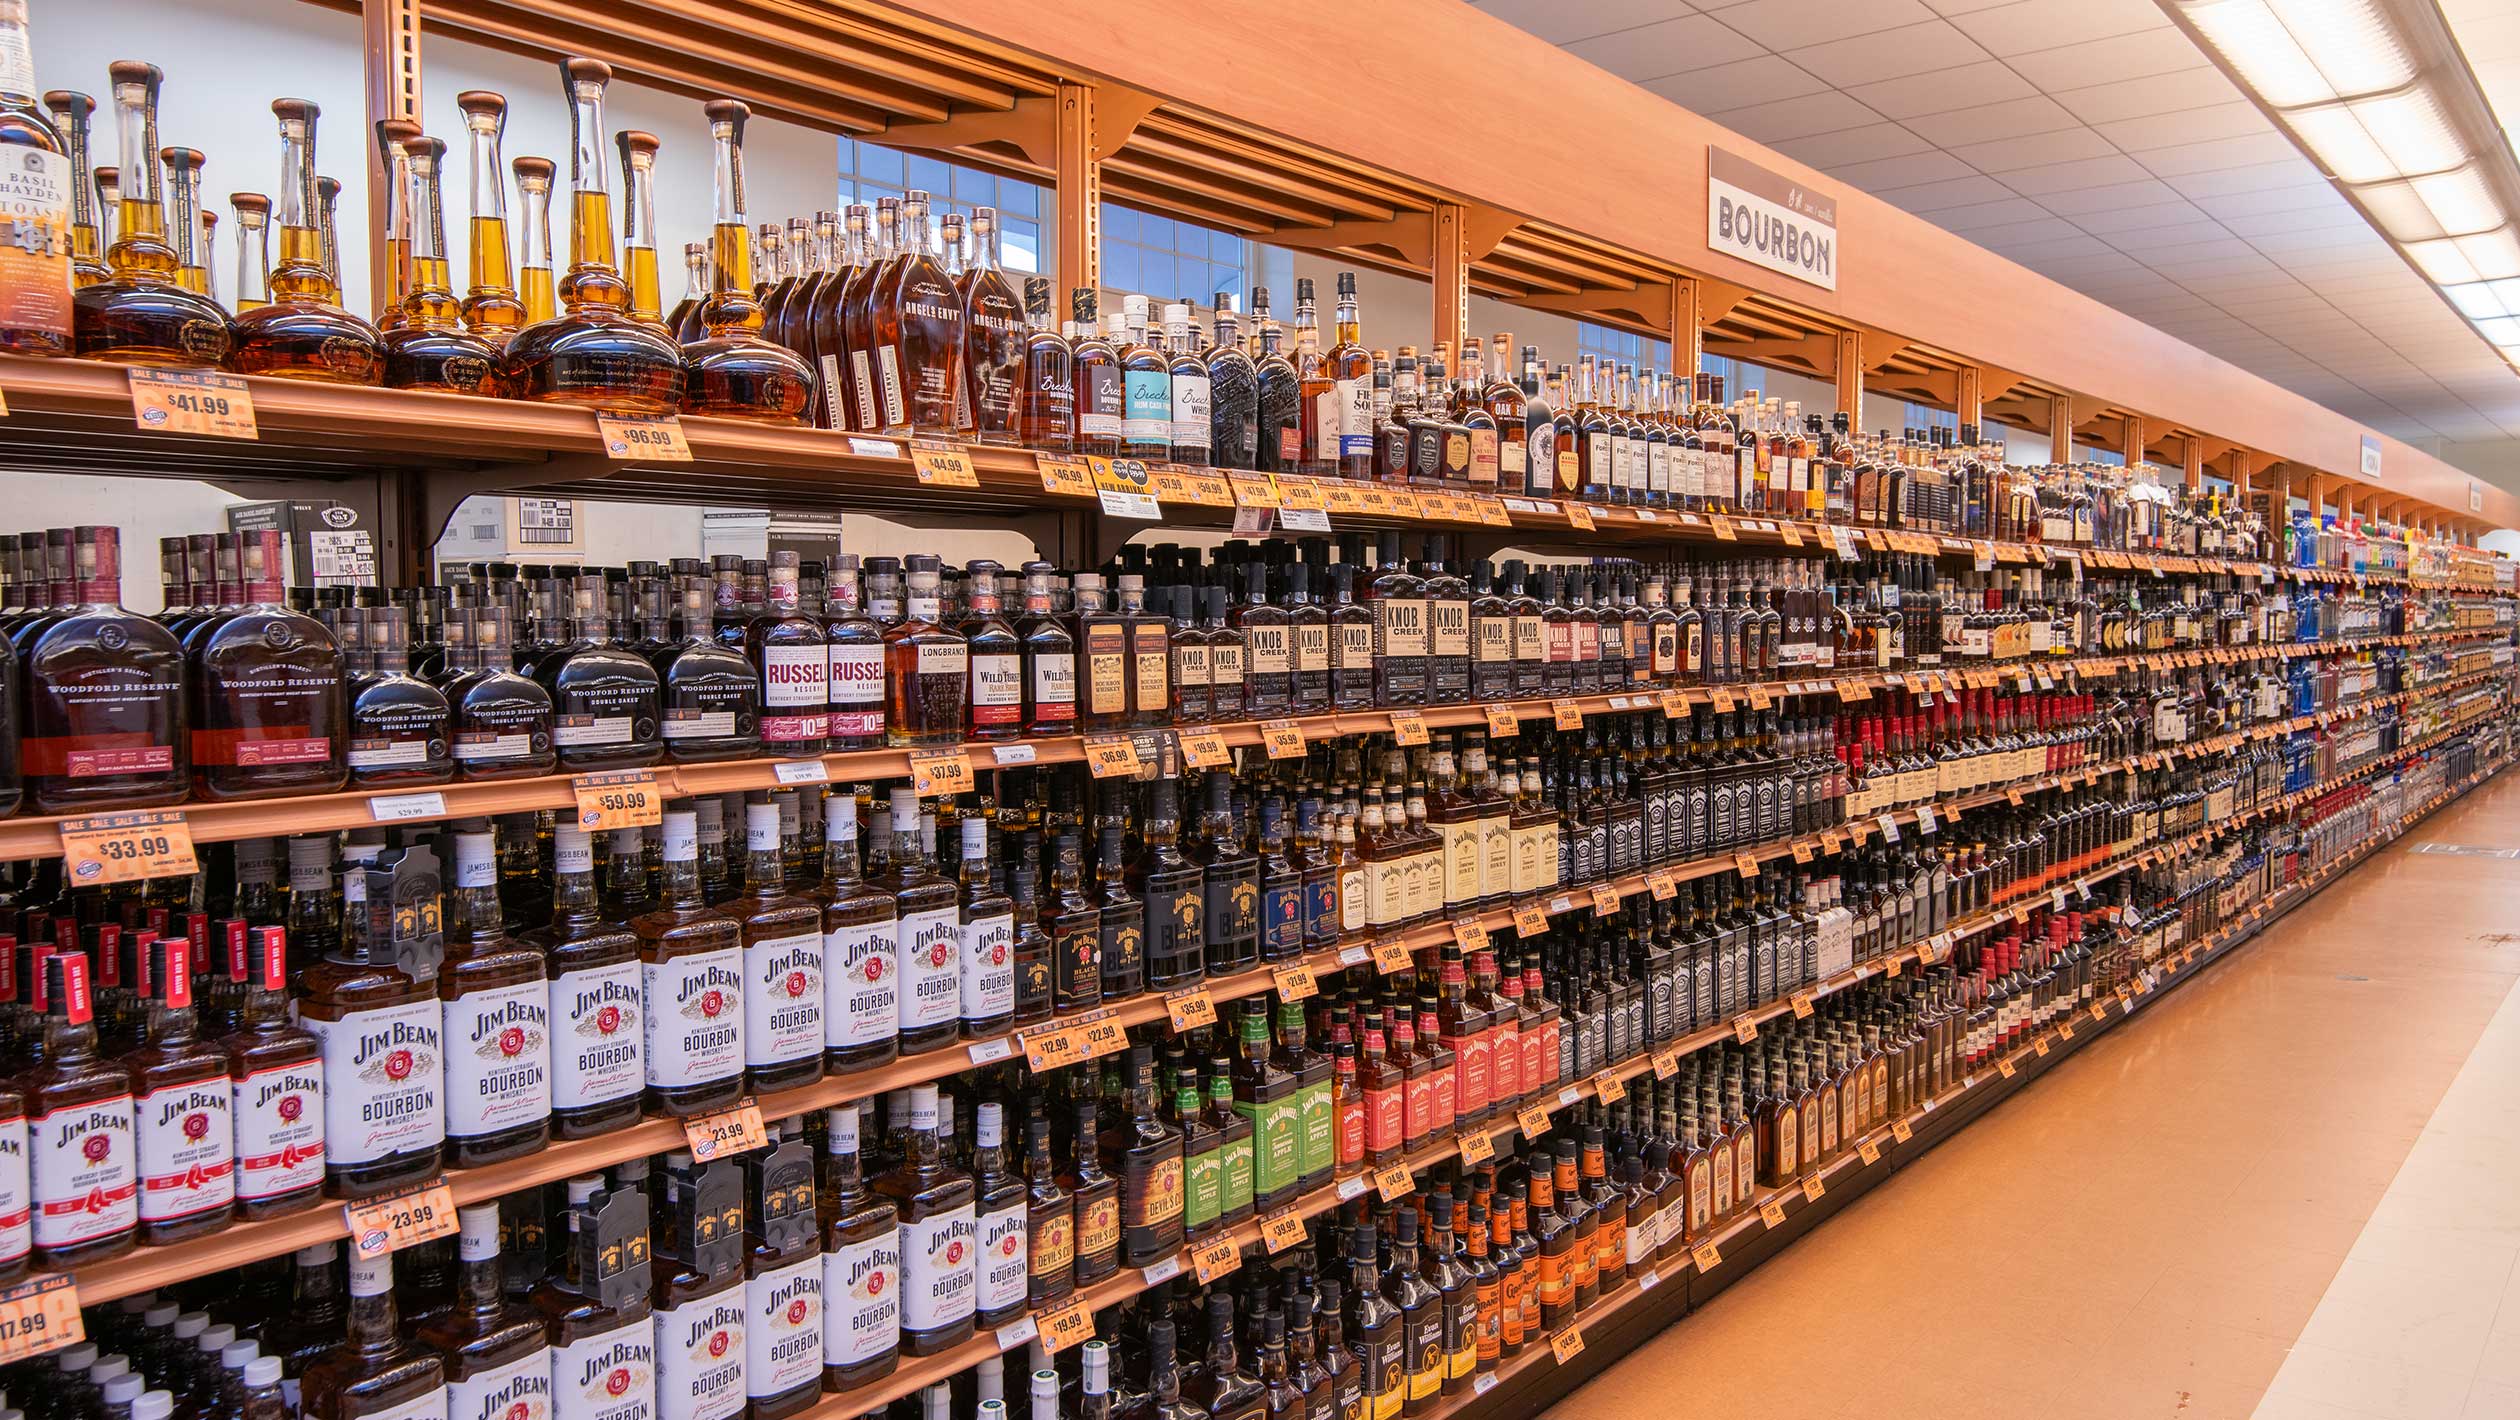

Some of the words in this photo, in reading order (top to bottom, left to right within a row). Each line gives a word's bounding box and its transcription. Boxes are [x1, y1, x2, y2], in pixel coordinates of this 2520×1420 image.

[10, 173, 56, 189] BASIL
[0, 183, 63, 201] HAYDEN
[0, 201, 65, 222] TOAST
[1719, 196, 1830, 276] BOURBON
[938, 306, 959, 322] ENVY
[131, 369, 152, 378] SALE
[156, 372, 176, 380] SALE
[180, 374, 199, 383] SALE
[204, 377, 222, 385] SALE
[225, 379, 244, 387] SALE
[168, 393, 230, 415] $41.99
[624, 429, 672, 445] $96.99
[929, 458, 963, 472] $44.99
[1053, 468, 1083, 483] $46.99
[1388, 607, 1418, 628] KNOB
[1482, 623, 1502, 639] KNOB
[1518, 622, 1538, 637] KNOB
[1602, 627, 1620, 642] KNOB
[1254, 631, 1282, 649] KNOB
[1301, 630, 1323, 647] KNOB
[922, 647, 965, 657] LONGBRANCH
[1182, 651, 1204, 665] KNOB
[80, 667, 122, 680] DISTILLER'S
[124, 668, 151, 678] SELECT
[249, 664, 287, 674] DISTILLER'S
[287, 664, 312, 673] SELECT
[980, 672, 1002, 683] WILD
[1043, 670, 1063, 682] WILD
[48, 684, 121, 694] WOODFORD
[125, 682, 181, 691] RESERVE
[221, 680, 285, 689] WOODFORD
[288, 678, 338, 686] RESERVE
[570, 689, 618, 698] WOODFORD
[620, 687, 656, 695] RESERVE
[591, 698, 617, 706] DOUBLE
[800, 719, 816, 736] 10
[863, 714, 876, 731] 10
[1194, 742, 1217, 754] $19.99
[1275, 734, 1298, 746] $35.99
[1100, 750, 1129, 763] $36.99
[930, 765, 961, 780] $37.99
[599, 792, 646, 811] $59.99
[63, 821, 86, 831] SALE
[89, 819, 111, 828] SALE
[114, 816, 135, 825] SALE
[138, 814, 158, 823] SALE
[162, 812, 182, 821] SALE
[99, 837, 170, 860] $33.99
[1454, 834, 1464, 848] JACK
[1383, 947, 1402, 960] $24.99
[764, 955, 790, 983] JIM
[792, 948, 822, 973] BEAM
[1074, 966, 1096, 975] BLACK
[677, 974, 705, 1002] JIM
[708, 966, 741, 992] BEAM
[1287, 973, 1307, 987] $21.99
[571, 988, 601, 1019] JIM
[603, 981, 640, 1007] BEAM
[1180, 1000, 1207, 1015] $35.99
[471, 1013, 503, 1042] JIM
[506, 1000, 546, 1027] BEAM
[771, 1008, 820, 1030] BOURBON
[684, 1027, 737, 1051] BOURBON
[1088, 1025, 1115, 1042] $22.99
[354, 1030, 390, 1065] JIM
[392, 1022, 438, 1051] BEAM
[1040, 1037, 1069, 1054] $12.99
[579, 1043, 636, 1071] BOURBON
[1464, 1045, 1475, 1060] JACK
[488, 1066, 513, 1077] KENTUCKY
[514, 1060, 536, 1071] STRAIGHT
[480, 1067, 543, 1096] BOURBON
[1470, 1075, 1482, 1084] FIRE
[256, 1083, 281, 1108] JIM
[285, 1075, 319, 1094] BEAM
[500, 1088, 526, 1100] WHISKEY
[159, 1101, 187, 1126] JIM
[189, 1092, 227, 1112] BEAM
[363, 1091, 433, 1122] BOURBON
[1266, 1111, 1279, 1130] JACK
[58, 1119, 87, 1149] JIM
[90, 1112, 129, 1132] BEAM
[708, 1123, 744, 1142] $23.99
[1273, 1145, 1292, 1159] APPLE
[386, 1206, 433, 1230] $23.99
[1043, 1224, 1056, 1239] JIM
[1055, 1218, 1071, 1229] BEAM
[1274, 1219, 1297, 1236] $39.99
[1038, 1248, 1062, 1268] DEVIL'S
[1062, 1244, 1073, 1258] CUT
[1206, 1246, 1231, 1265] $24.99
[766, 1284, 792, 1315] JIM
[793, 1276, 821, 1297] BEAM
[686, 1315, 714, 1348] JIM
[715, 1306, 744, 1328] BEAM
[1424, 1323, 1439, 1334] Evan
[772, 1331, 819, 1361] BOURBON
[692, 1364, 741, 1396] BOURBON
